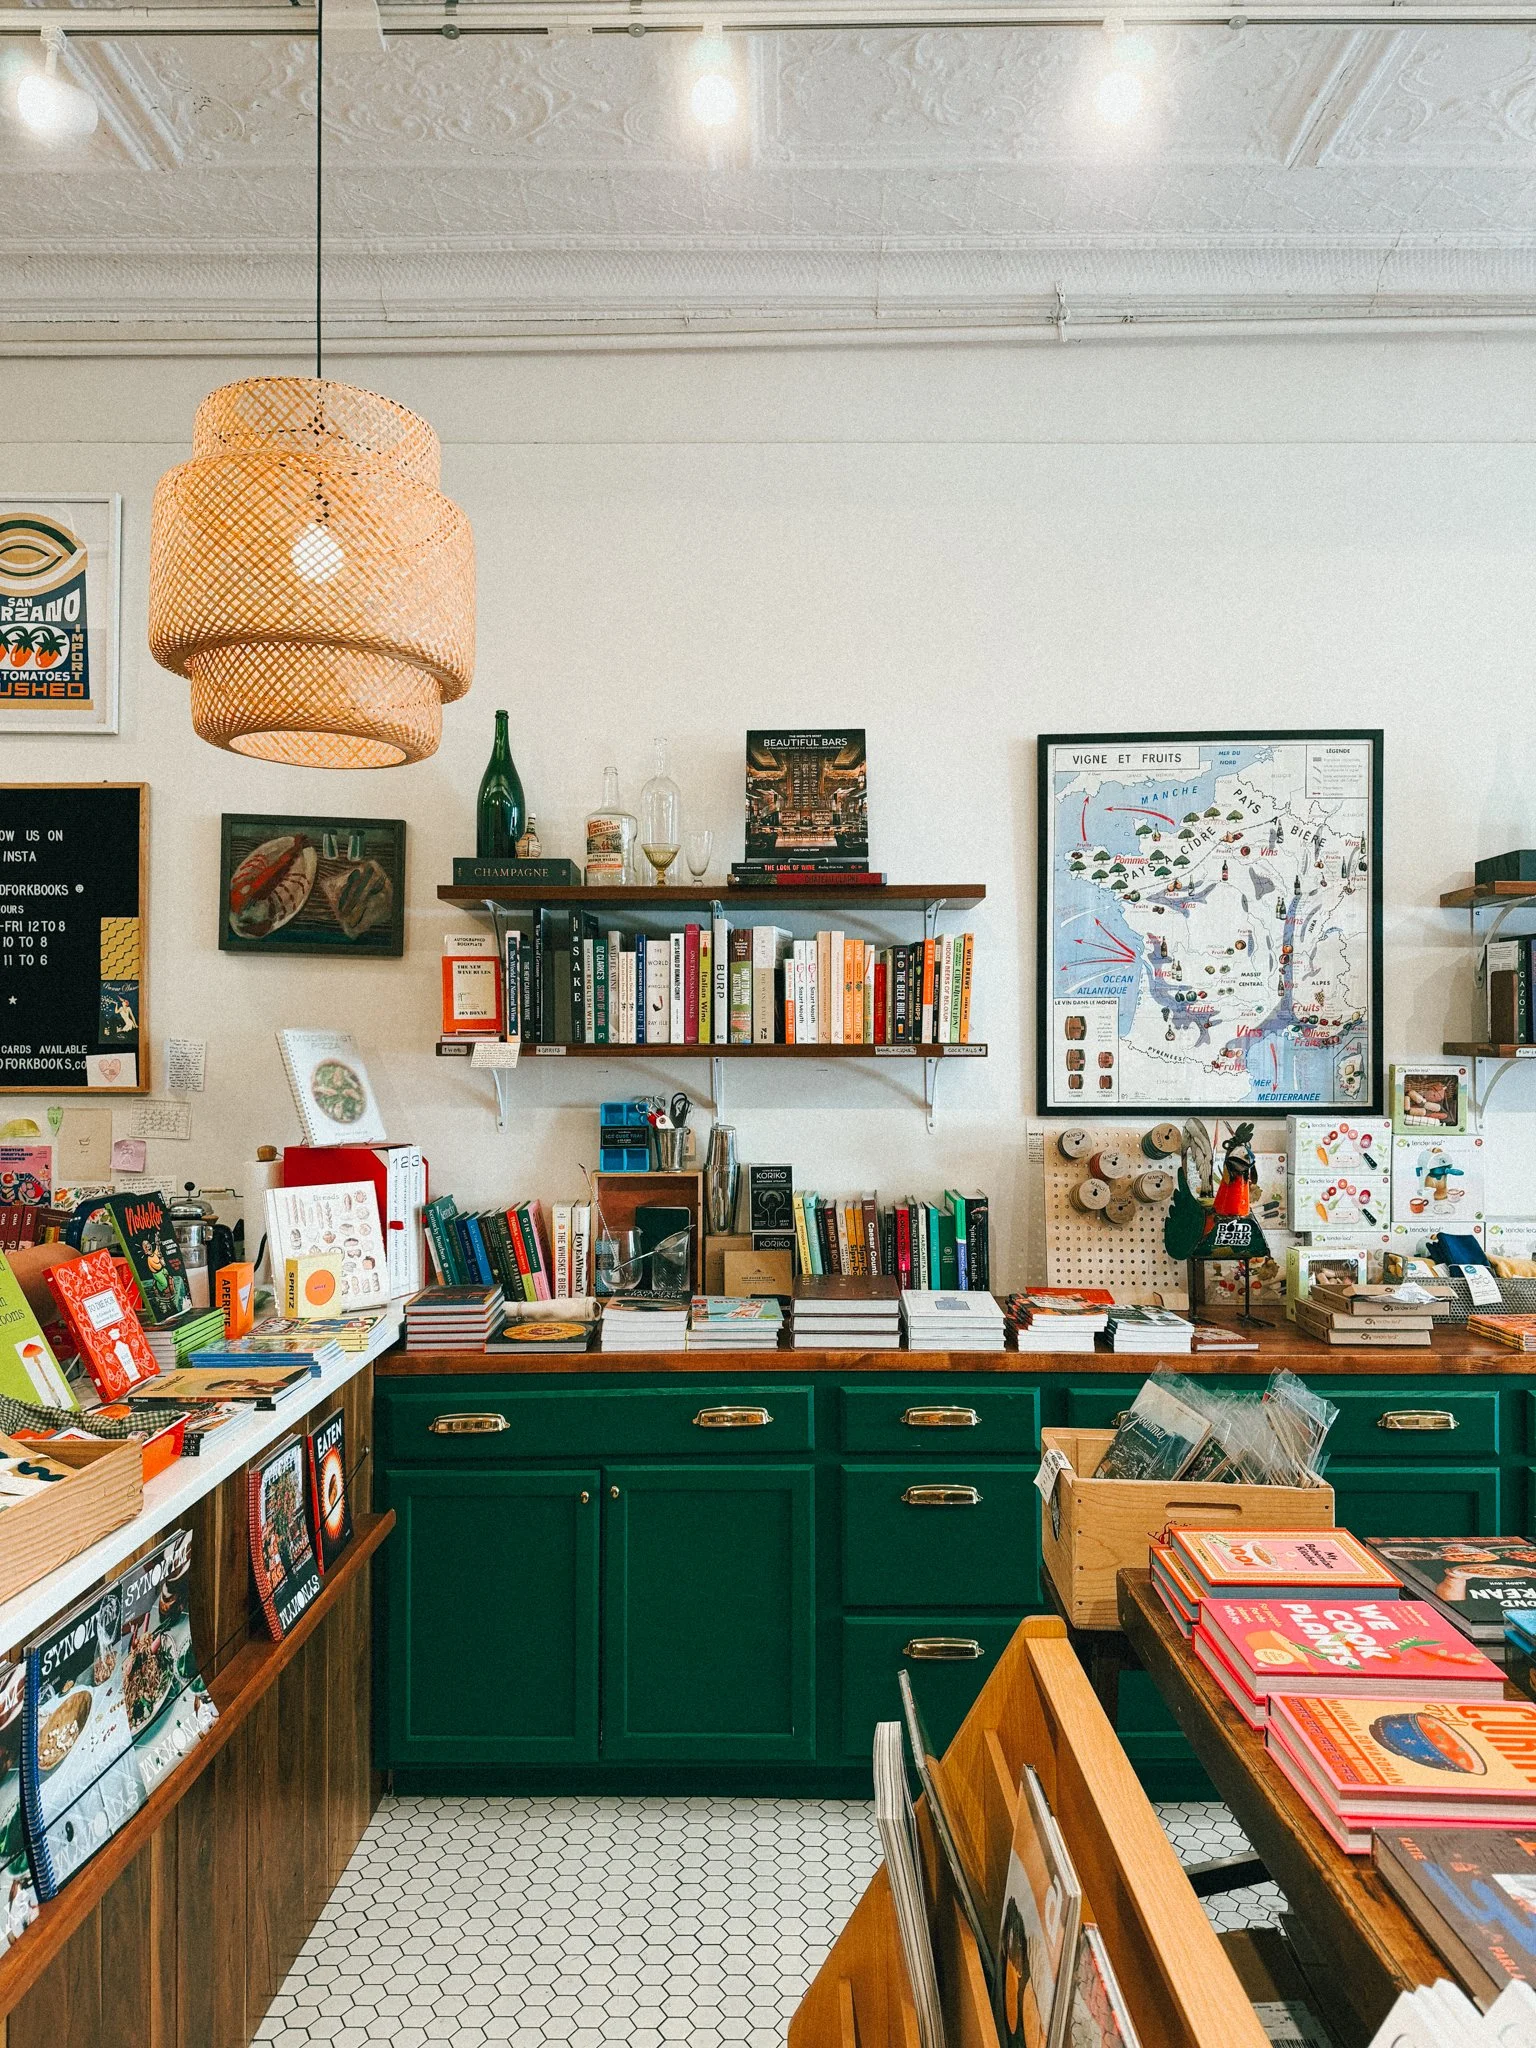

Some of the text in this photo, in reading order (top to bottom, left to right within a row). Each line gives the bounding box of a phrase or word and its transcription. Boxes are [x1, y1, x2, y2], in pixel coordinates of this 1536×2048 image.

[8, 598, 32, 607] SAN
[72, 624, 84, 681] IMPORT
[1, 671, 70, 681] TOMATOES
[764, 738, 848, 747] BEAUTIFUL BARS
[1072, 753, 1182, 764] VIGNE ET FRUITS
[1141, 785, 1198, 804] MANCHE
[1233, 788, 1326, 847] PAYS BIÈRE
[26, 830, 40, 841] US
[48, 830, 63, 841] ON
[3, 851, 37, 862] INSTA
[1123, 826, 1216, 882] PAYS CIDRE
[1260, 848, 1278, 857] Vins
[1114, 856, 1149, 865] Pommes
[474, 868, 549, 877] CHAMPAGNE
[1, 905, 24, 914] OURS
[28, 921, 66, 932] 12 TO 8
[1285, 917, 1304, 925] Vins
[1308, 919, 1317, 934] JURA
[2, 936, 48, 947] 10 TO 8
[4, 955, 48, 966] 11 TO 6
[573, 947, 581, 1001] SAKE
[1154, 968, 1172, 977] Vins
[597, 946, 605, 1026] OZ CLARKE'S STORY WINE
[716, 964, 725, 999] BURP
[896, 971, 905, 1020] THE BEER BIBLE
[1077, 987, 1127, 995] ATLANTIQUE
[1186, 1004, 1214, 1013] Fruits
[1292, 1003, 1320, 1012] Fruits
[1236, 1025, 1263, 1038] Vins
[1304, 1028, 1330, 1038] Olives
[1294, 1038, 1321, 1047] Fruits
[1, 1045, 88, 1055] CARDS AVAILABLE
[1218, 1062, 1246, 1071] Fruits
[1258, 1092, 1321, 1100] MÉDITERRANÉE
[393, 1158, 398, 1170] 1
[401, 1157, 409, 1168] 2
[412, 1155, 419, 1167] 3
[522, 1217, 530, 1233] GIN
[827, 1218, 835, 1242] BEHIND
[1219, 1221, 1250, 1232] BOLD
[428, 1210, 446, 1260] Kentucky Bourbon
[867, 1222, 875, 1249] Caesar
[506, 1240, 522, 1291] AGAVE SPIRITS
[557, 1231, 567, 1298] THE WHISKEY BIBLE
[573, 1232, 584, 1294] LOVE WHISKEY
[1121, 1408, 1168, 1446] Gourmet
[317, 1418, 342, 1459] EATEN
[1296, 1546, 1319, 1567] Kitchen
[1305, 1543, 1333, 1569] Bohemian
[1325, 1551, 1338, 1561] My
[1469, 1588, 1536, 1599] REAN
[1353, 1604, 1400, 1631] WE
[1280, 1604, 1361, 1667] PLANTS
[1323, 1609, 1392, 1659] COOK
[1327, 1699, 1362, 1733] MAUNIKA
[1398, 1837, 1428, 1861] KATIE
